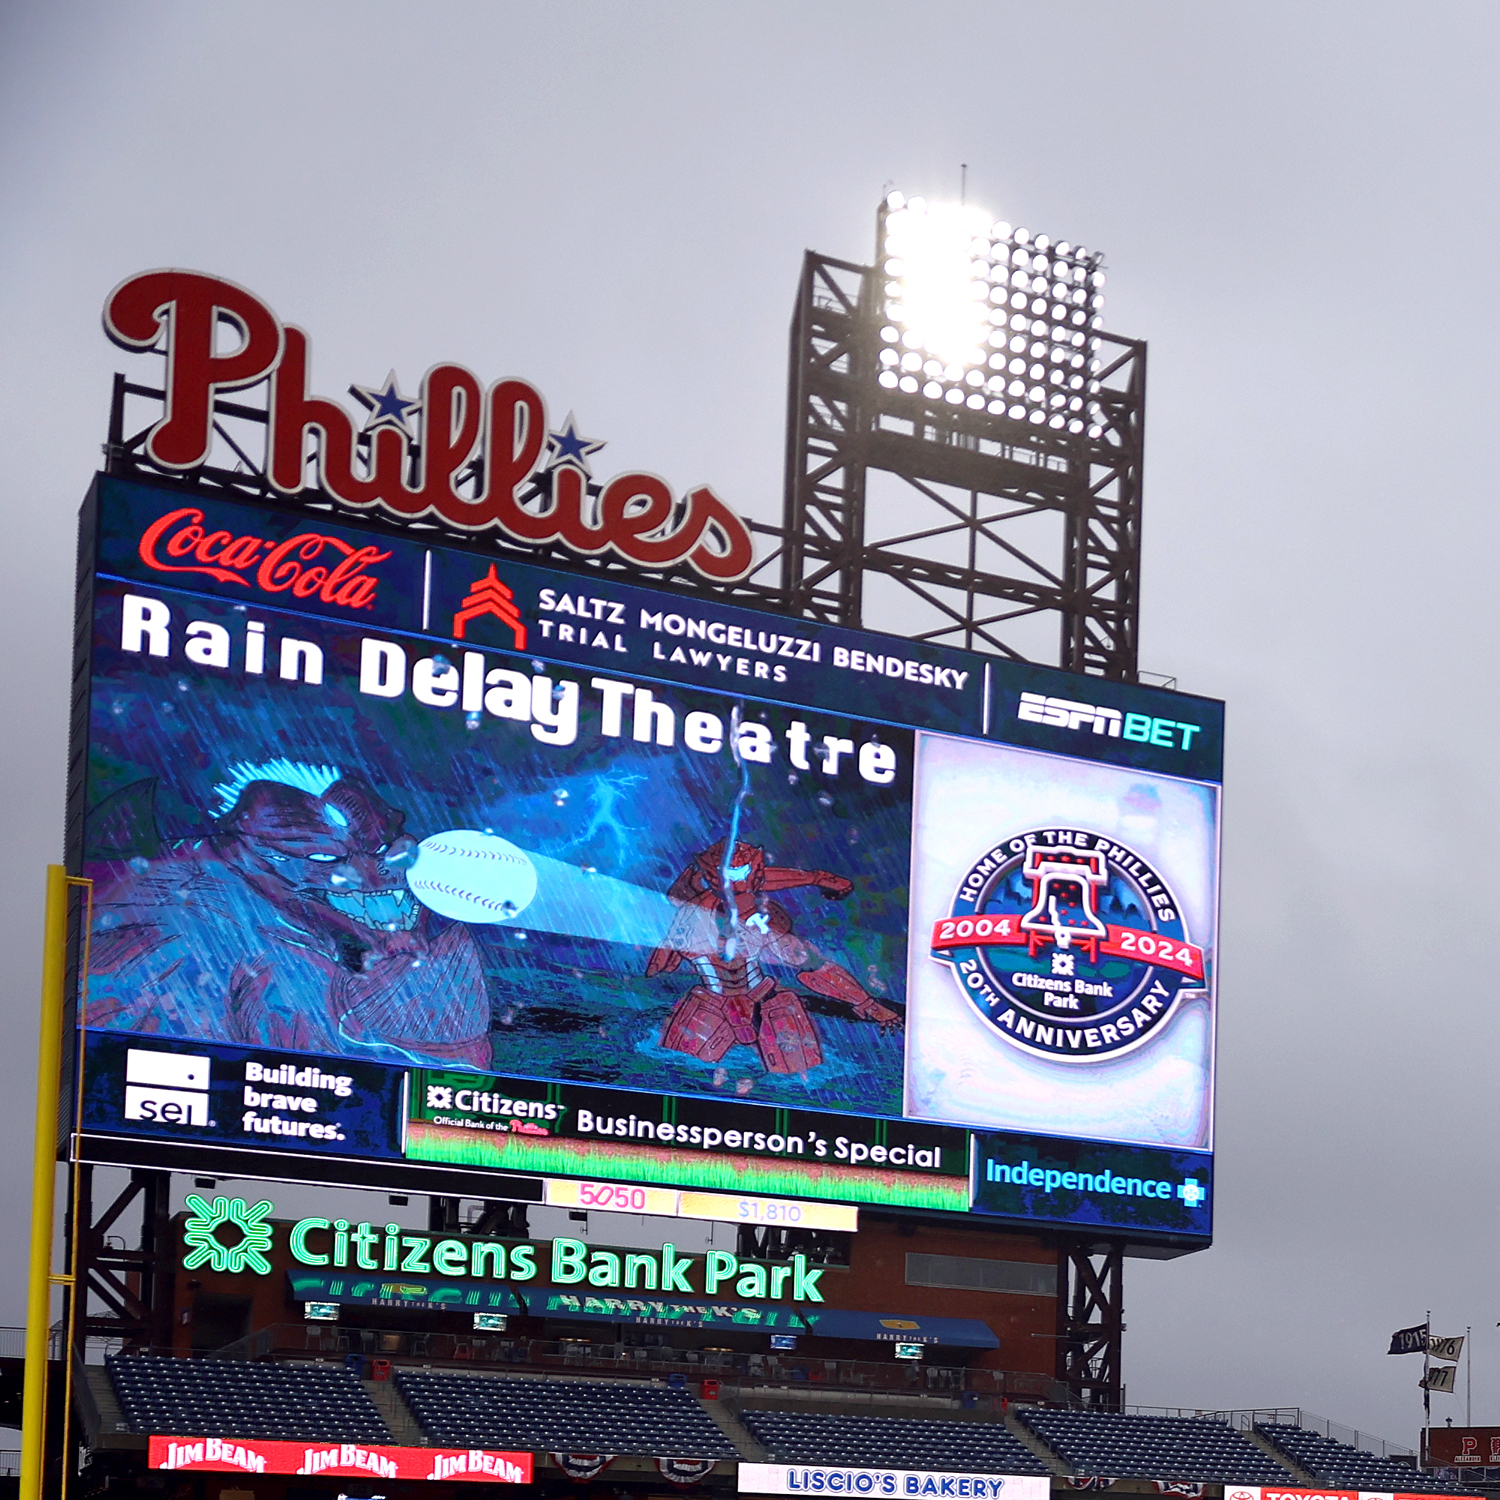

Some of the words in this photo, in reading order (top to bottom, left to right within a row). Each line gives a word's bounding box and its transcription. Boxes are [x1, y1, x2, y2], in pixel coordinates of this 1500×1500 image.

[102, 267, 754, 582] Phillies
[139, 507, 393, 611] Coca-Cola
[537, 586, 626, 627] SALTZ
[640, 608, 821, 664] MONGELUZZI
[832, 646, 968, 691] BENDESKY
[538, 618, 628, 654] TRIAL
[652, 643, 789, 684] LAWYERS
[120, 593, 325, 686] Rain
[359, 637, 579, 747] Delay
[589, 676, 898, 785] Theatre
[1123, 713, 1201, 751] BET
[959, 848, 1009, 903] HOME
[1009, 834, 1037, 852] OF
[1043, 831, 1088, 847] THE
[1095, 839, 1176, 923] PHILLIES
[939, 919, 1011, 940] 2004
[1120, 932, 1193, 967] 2024
[1011, 972, 1072, 993] Citizens
[1074, 979, 1114, 998] Bank
[1043, 991, 1080, 1010] Park
[960, 959, 1000, 1007] 20TH
[997, 979, 1171, 1049] ANNIVERSARY
[245, 1061, 354, 1097] Building
[243, 1085, 319, 1114] brave
[455, 1089, 557, 1120] Citizens
[242, 1112, 346, 1142] futures.
[433, 1115, 464, 1127] Official
[465, 1119, 485, 1130] Bank
[577, 1108, 828, 1158] Businessperson's
[834, 1136, 942, 1168] Special
[986, 1158, 1172, 1199] Independence
[738, 1201, 802, 1224] $1,810
[289, 1216, 538, 1282] Citizens
[551, 1236, 695, 1294] Bank
[704, 1249, 826, 1303] Park
[159, 1441, 203, 1470] JIM
[204, 1437, 267, 1474] BEAM
[297, 1448, 340, 1476] JIM
[340, 1444, 398, 1479] BEAM
[786, 1467, 897, 1495] LISCIO'S
[904, 1474, 1004, 1500] BAKERY
